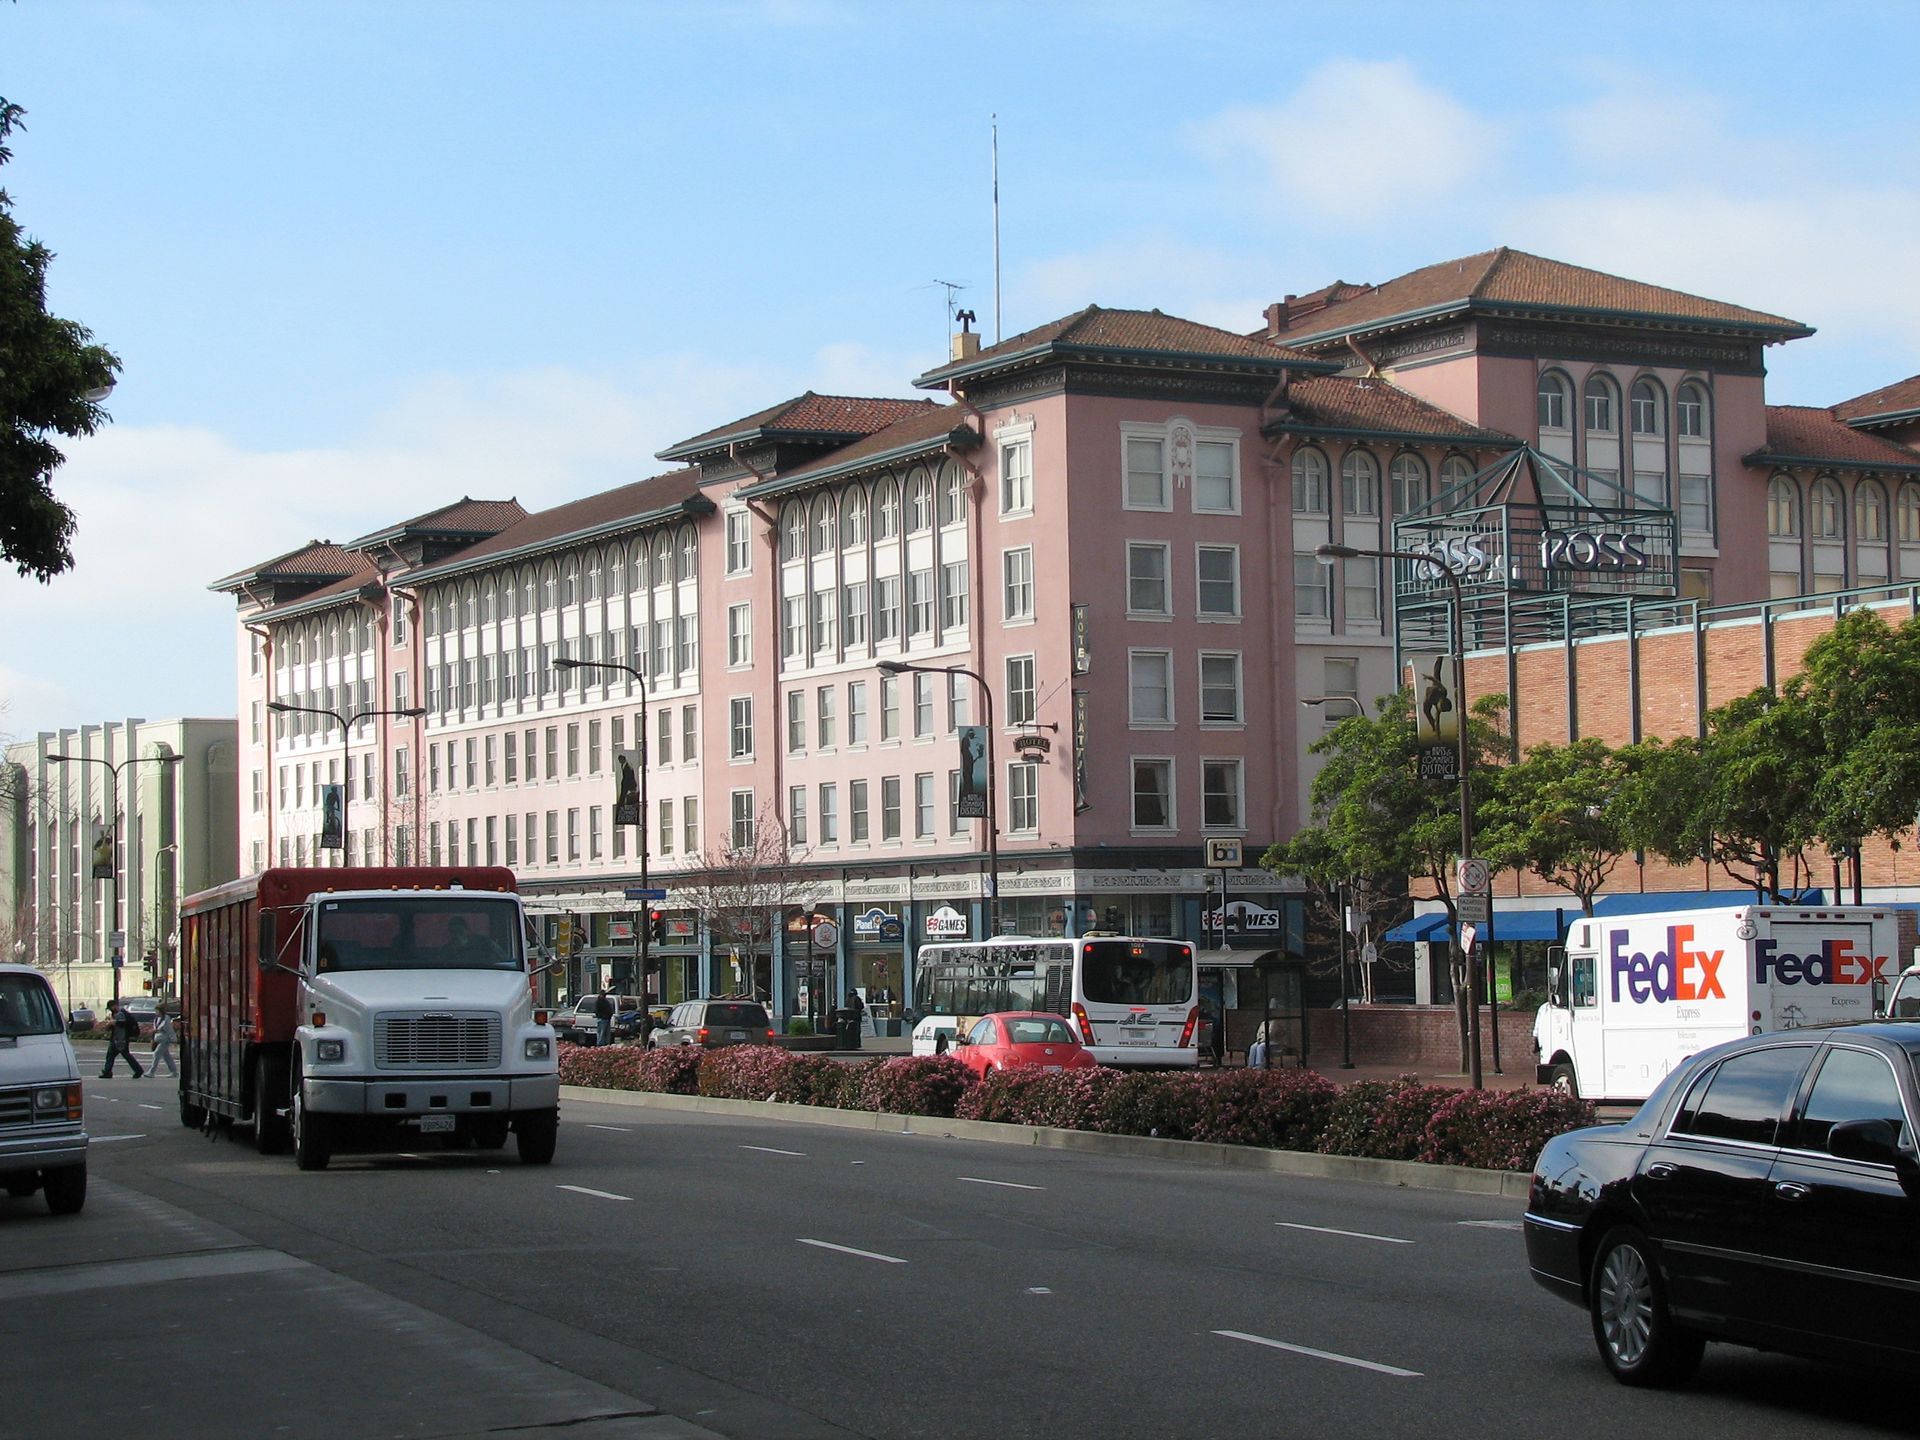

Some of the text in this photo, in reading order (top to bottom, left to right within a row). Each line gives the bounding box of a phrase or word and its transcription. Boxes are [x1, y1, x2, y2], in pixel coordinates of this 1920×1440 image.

[1541, 531, 1645, 573] ROSS
[1076, 609, 1085, 671] HOTEL
[1421, 764, 1454, 774] DISTRICT
[938, 919, 966, 931] GAMES
[1610, 924, 1726, 1004] FedEx
[1755, 939, 1890, 986] FedEx
[1676, 1005, 1701, 1022] Express
[1831, 996, 1861, 1008] Express
